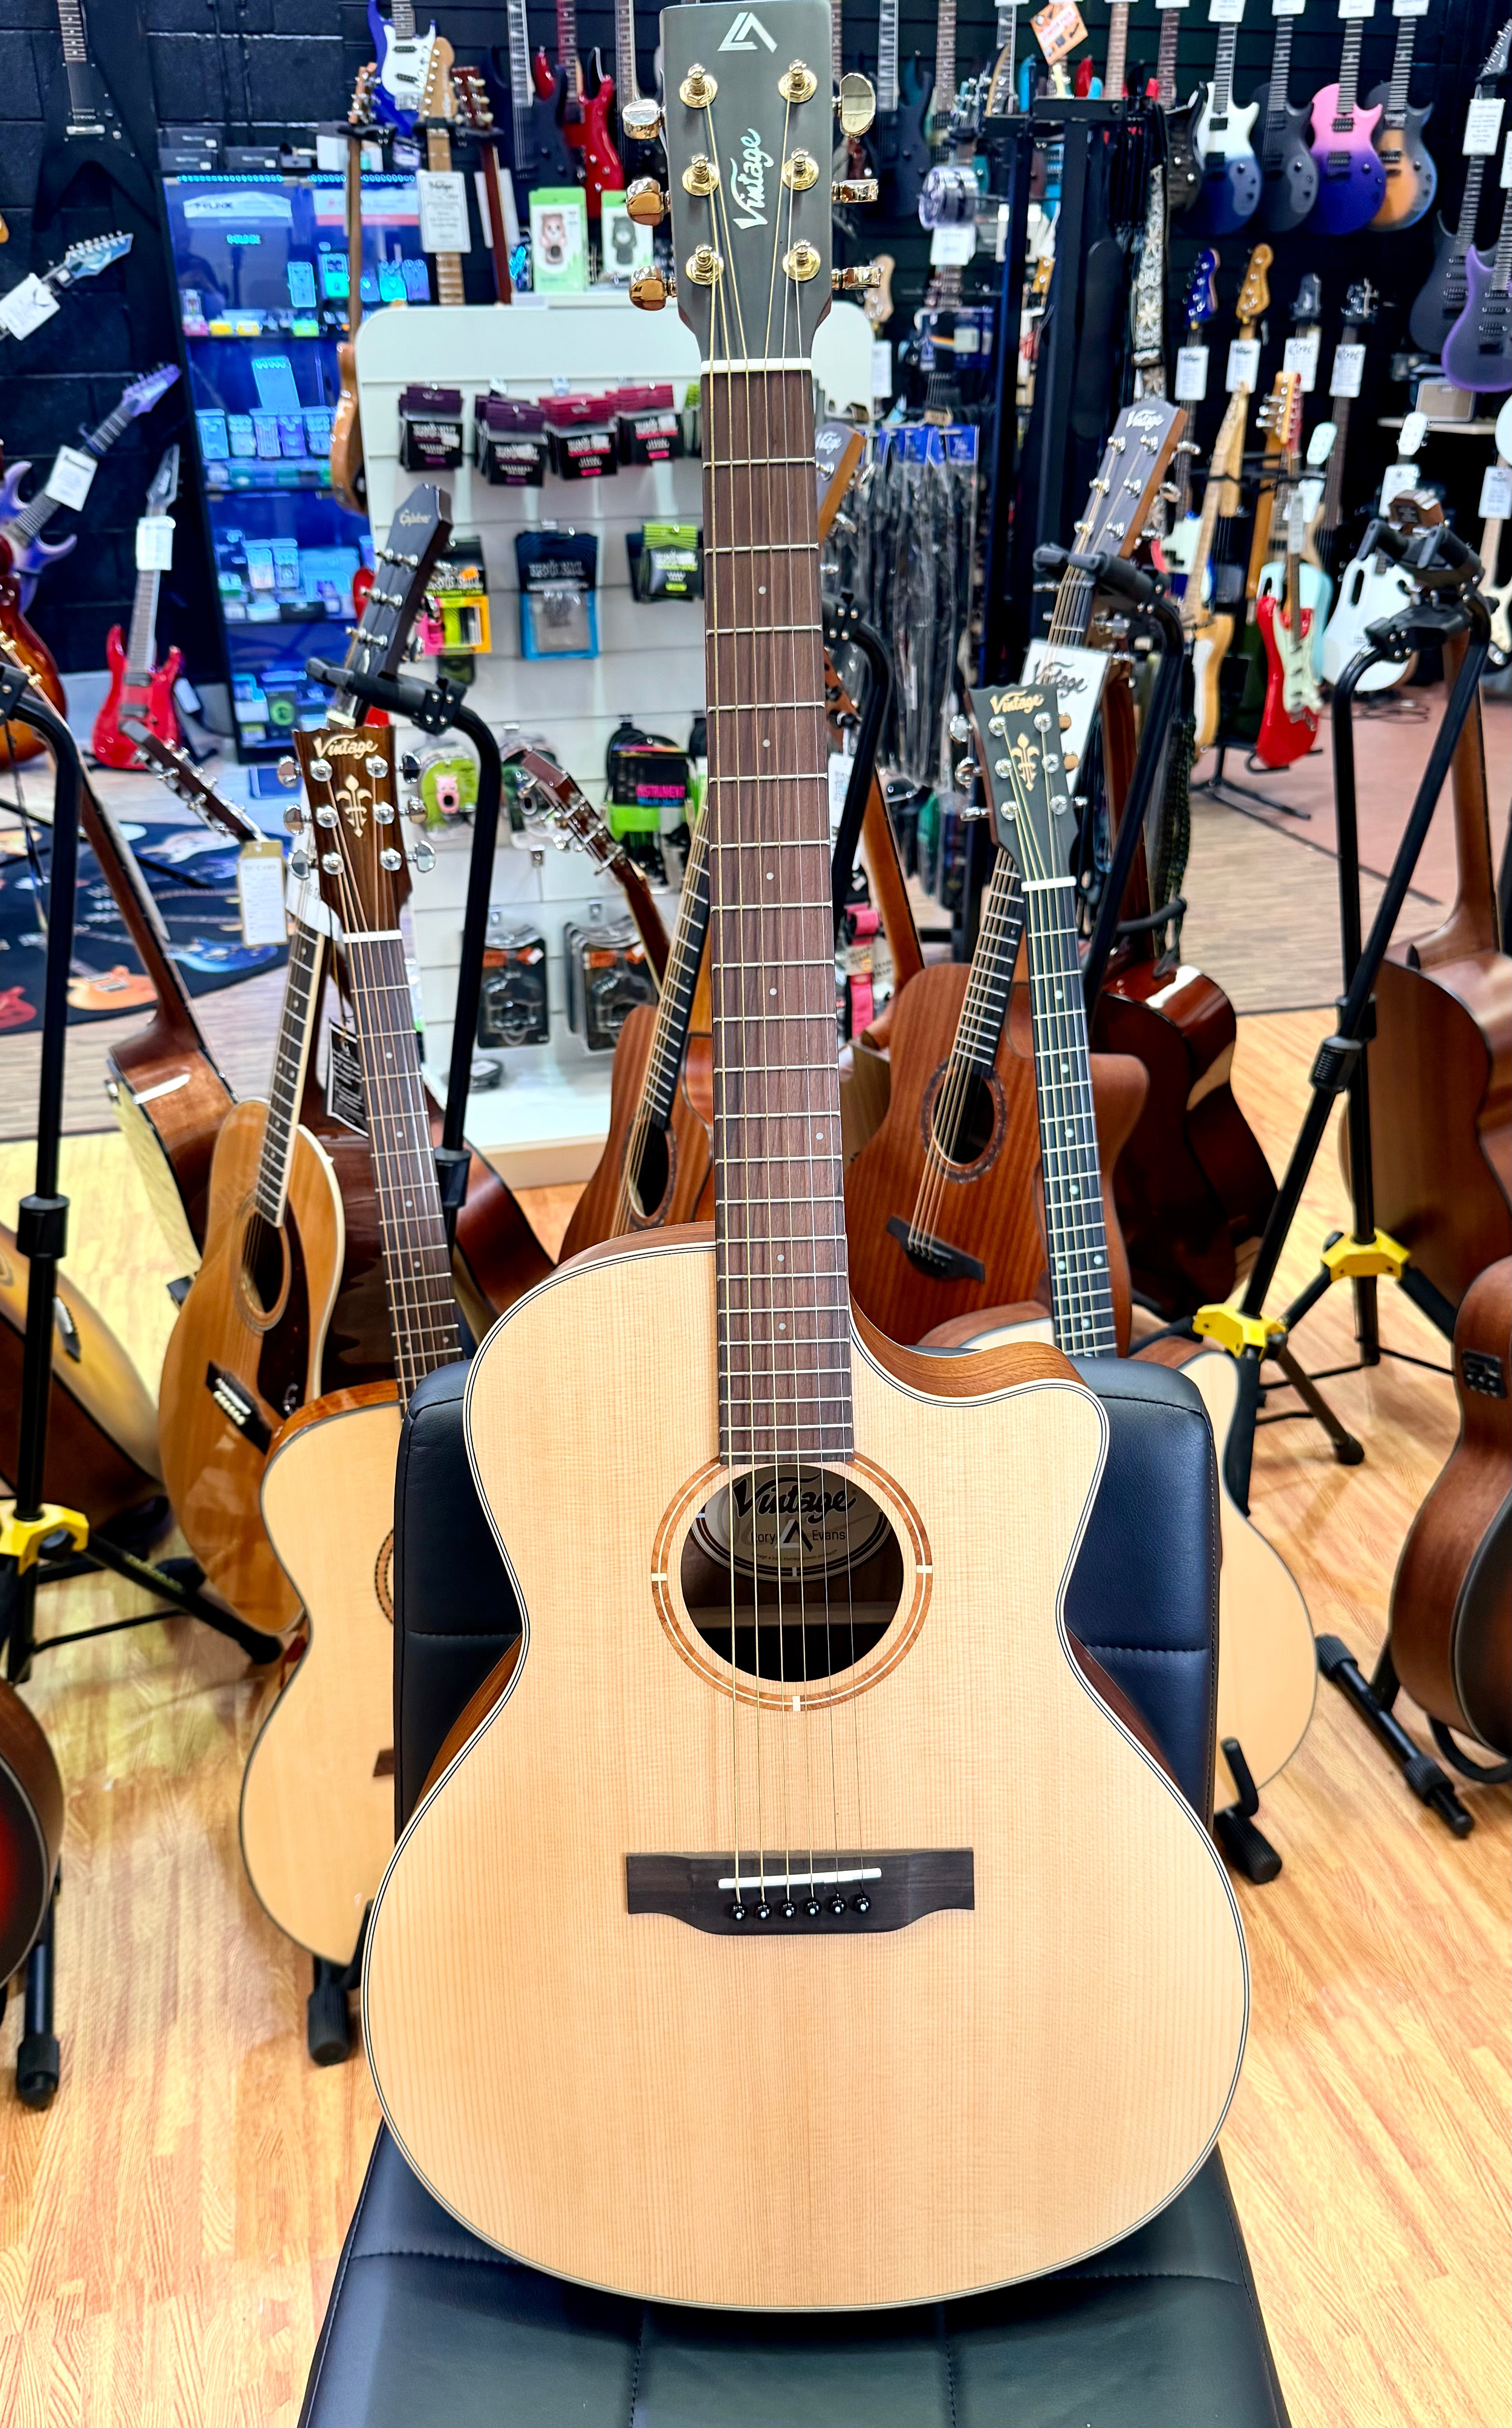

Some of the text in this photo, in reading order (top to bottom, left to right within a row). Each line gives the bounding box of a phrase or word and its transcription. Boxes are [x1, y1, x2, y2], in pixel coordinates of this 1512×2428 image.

[730, 128, 774, 230] Vintage
[1126, 409, 1166, 432] Vintage
[990, 690, 1045, 715] Vintage
[313, 733, 379, 760] Vintage
[732, 1473, 857, 1524] Vintage
[812, 1530, 846, 1541] Evans
